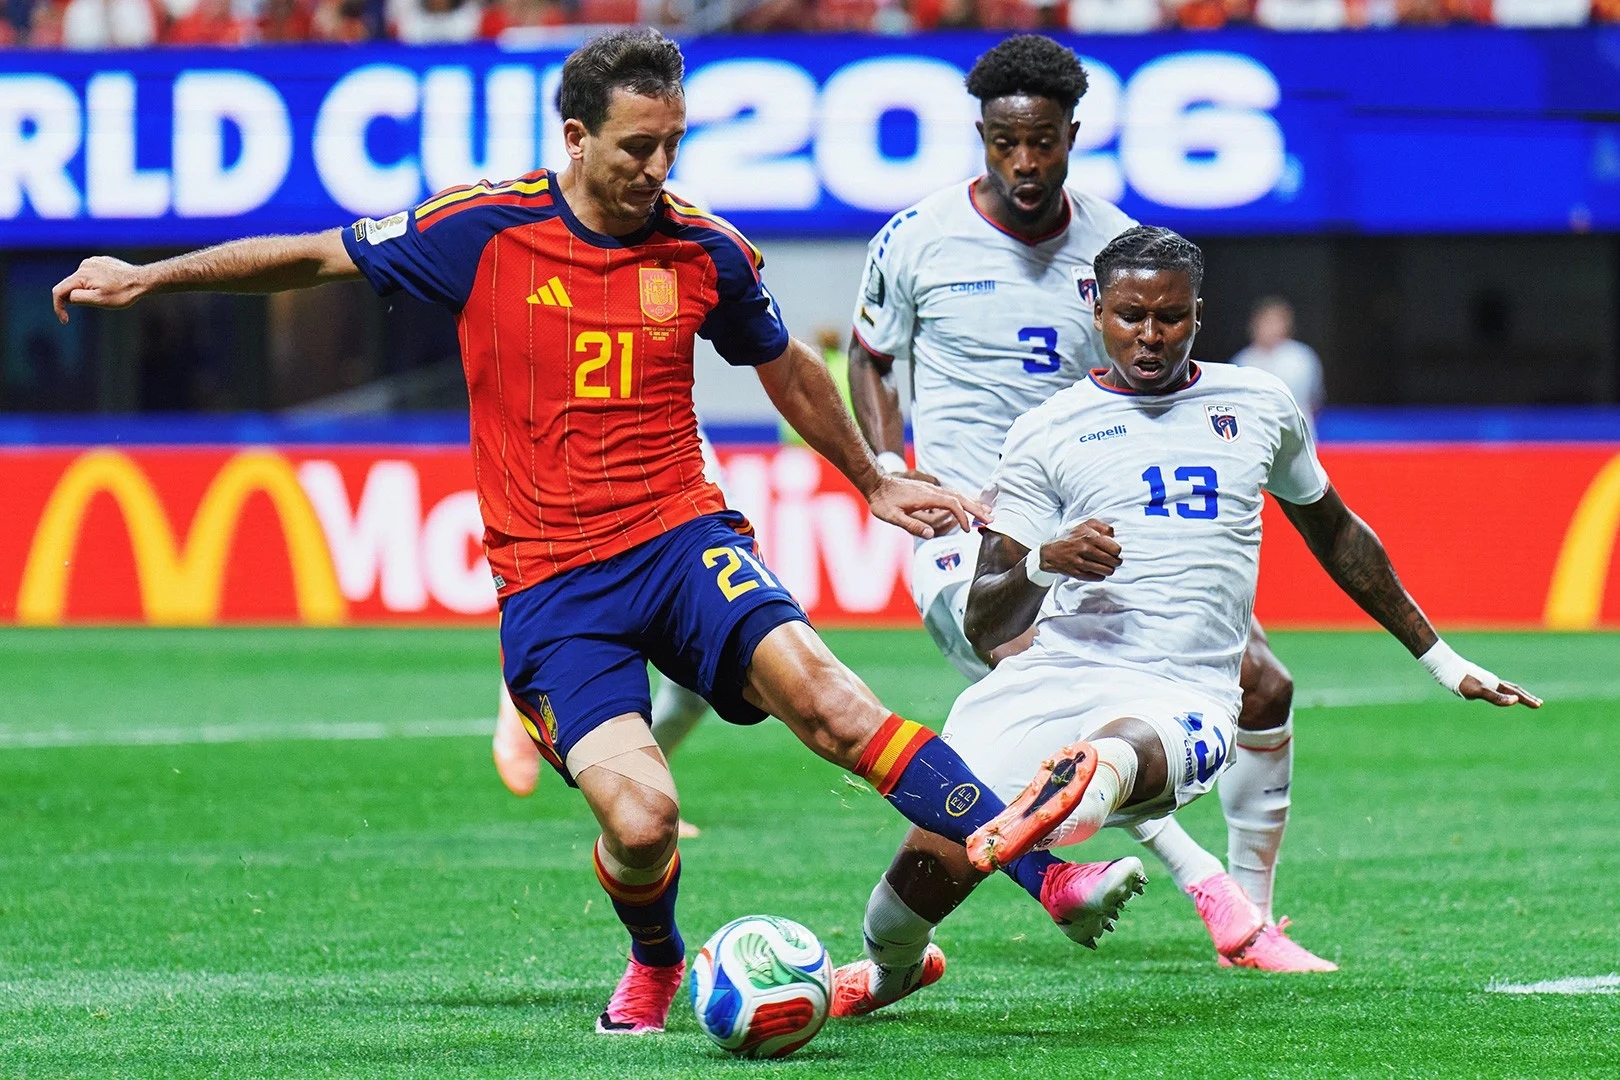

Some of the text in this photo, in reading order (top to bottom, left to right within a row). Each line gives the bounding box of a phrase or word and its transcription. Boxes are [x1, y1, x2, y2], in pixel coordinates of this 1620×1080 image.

[574, 331, 634, 399] 21
[1017, 327, 1061, 374] 3
[1079, 424, 1127, 443] capelli
[1207, 405, 1233, 413] FCF
[1141, 466, 1219, 520] 13
[702, 545, 778, 603] 21
